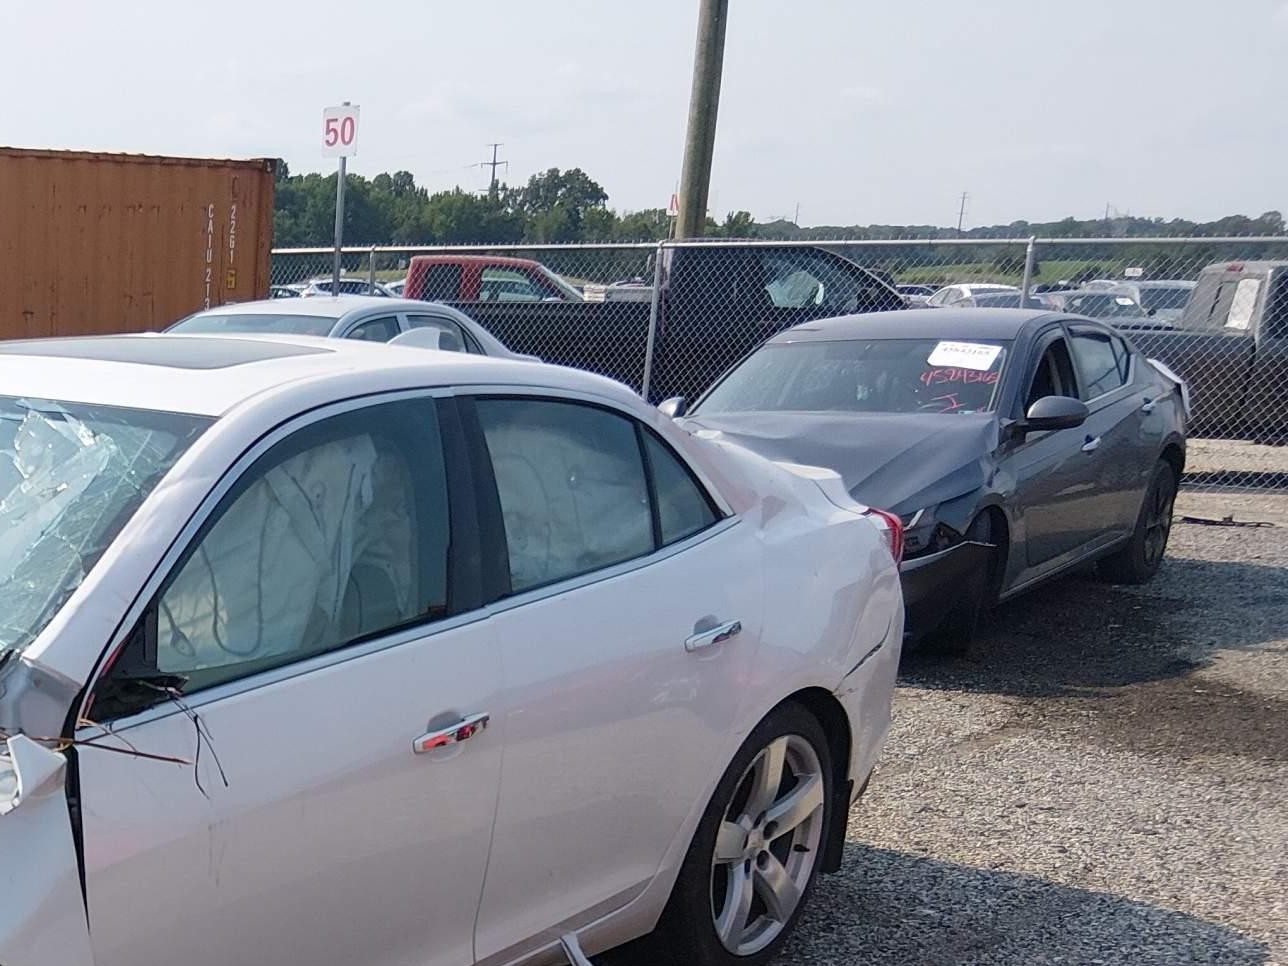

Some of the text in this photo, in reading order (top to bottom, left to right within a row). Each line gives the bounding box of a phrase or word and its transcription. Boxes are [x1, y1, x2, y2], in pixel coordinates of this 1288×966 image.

[325, 116, 355, 147] 50
[206, 203, 215, 264] CAIU
[229, 204, 237, 265] 22G1
